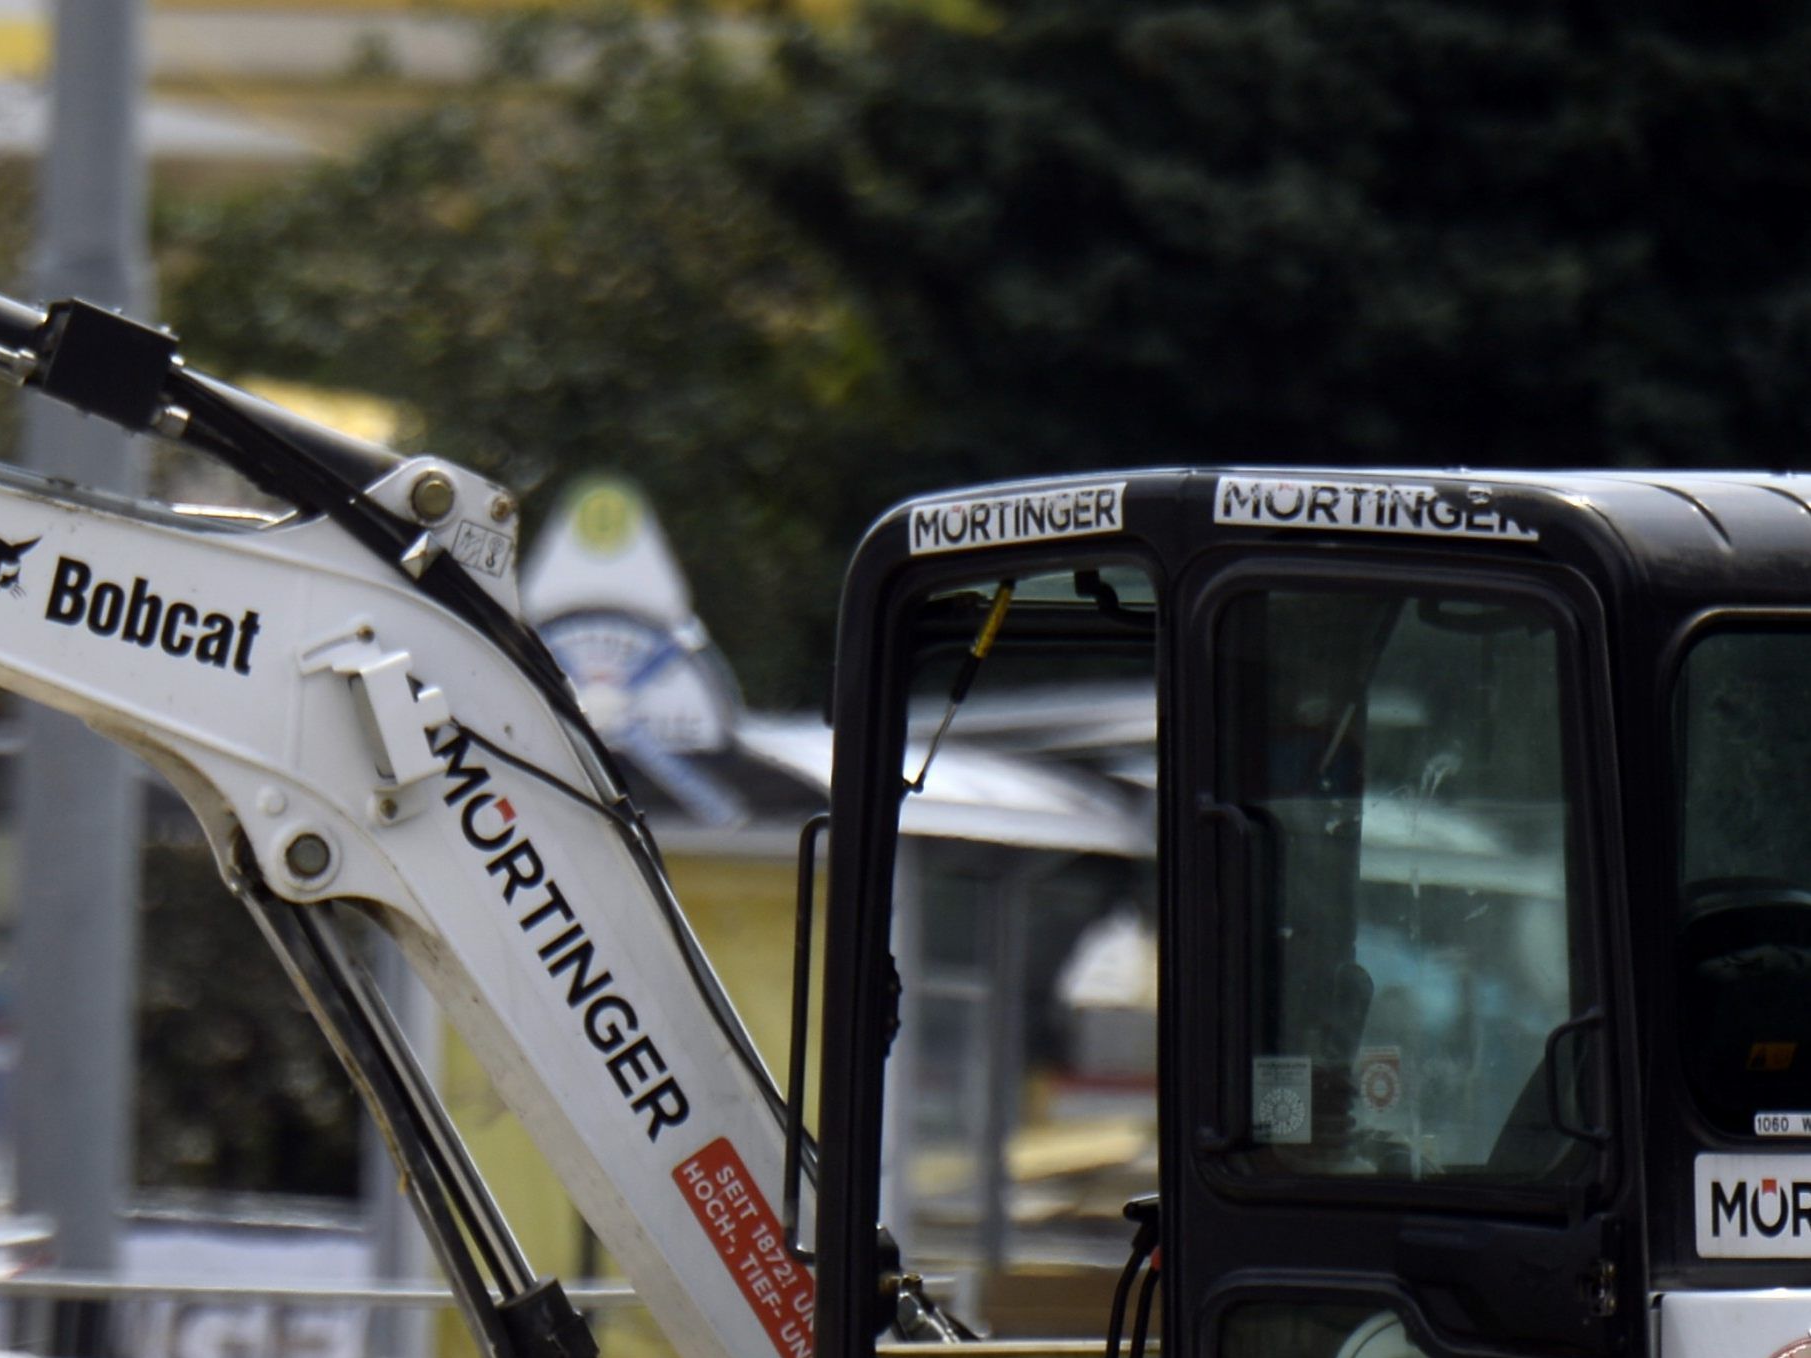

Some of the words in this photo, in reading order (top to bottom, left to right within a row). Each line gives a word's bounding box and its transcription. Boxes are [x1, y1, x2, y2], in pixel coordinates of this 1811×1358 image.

[45, 555, 260, 676] Bobcat
[1757, 1116, 1789, 1132] 1060
[683, 1160, 738, 1256] HOCH-,
[740, 1253, 783, 1320] TIEF-
[716, 1164, 759, 1221] SEIT
[751, 1224, 798, 1288] 1872!
